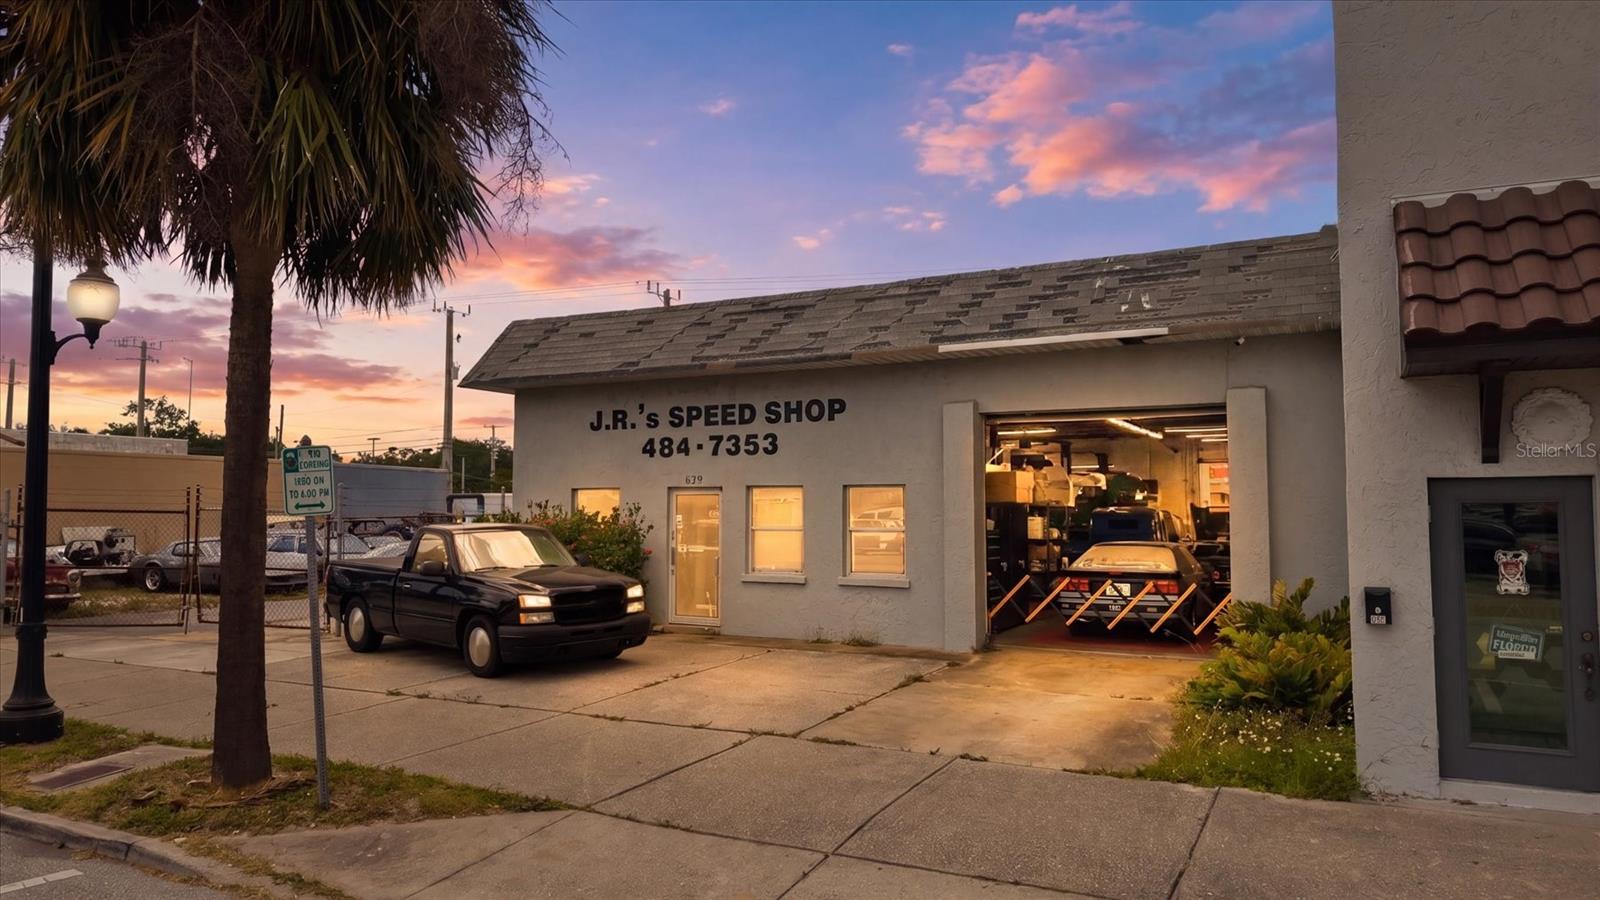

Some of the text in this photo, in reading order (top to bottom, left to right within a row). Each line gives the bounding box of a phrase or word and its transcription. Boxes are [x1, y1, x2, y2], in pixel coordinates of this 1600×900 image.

[668, 403, 757, 428] SPEED
[764, 398, 847, 424] SHOP
[685, 475, 703, 485] 639
[289, 490, 299, 499] TO
